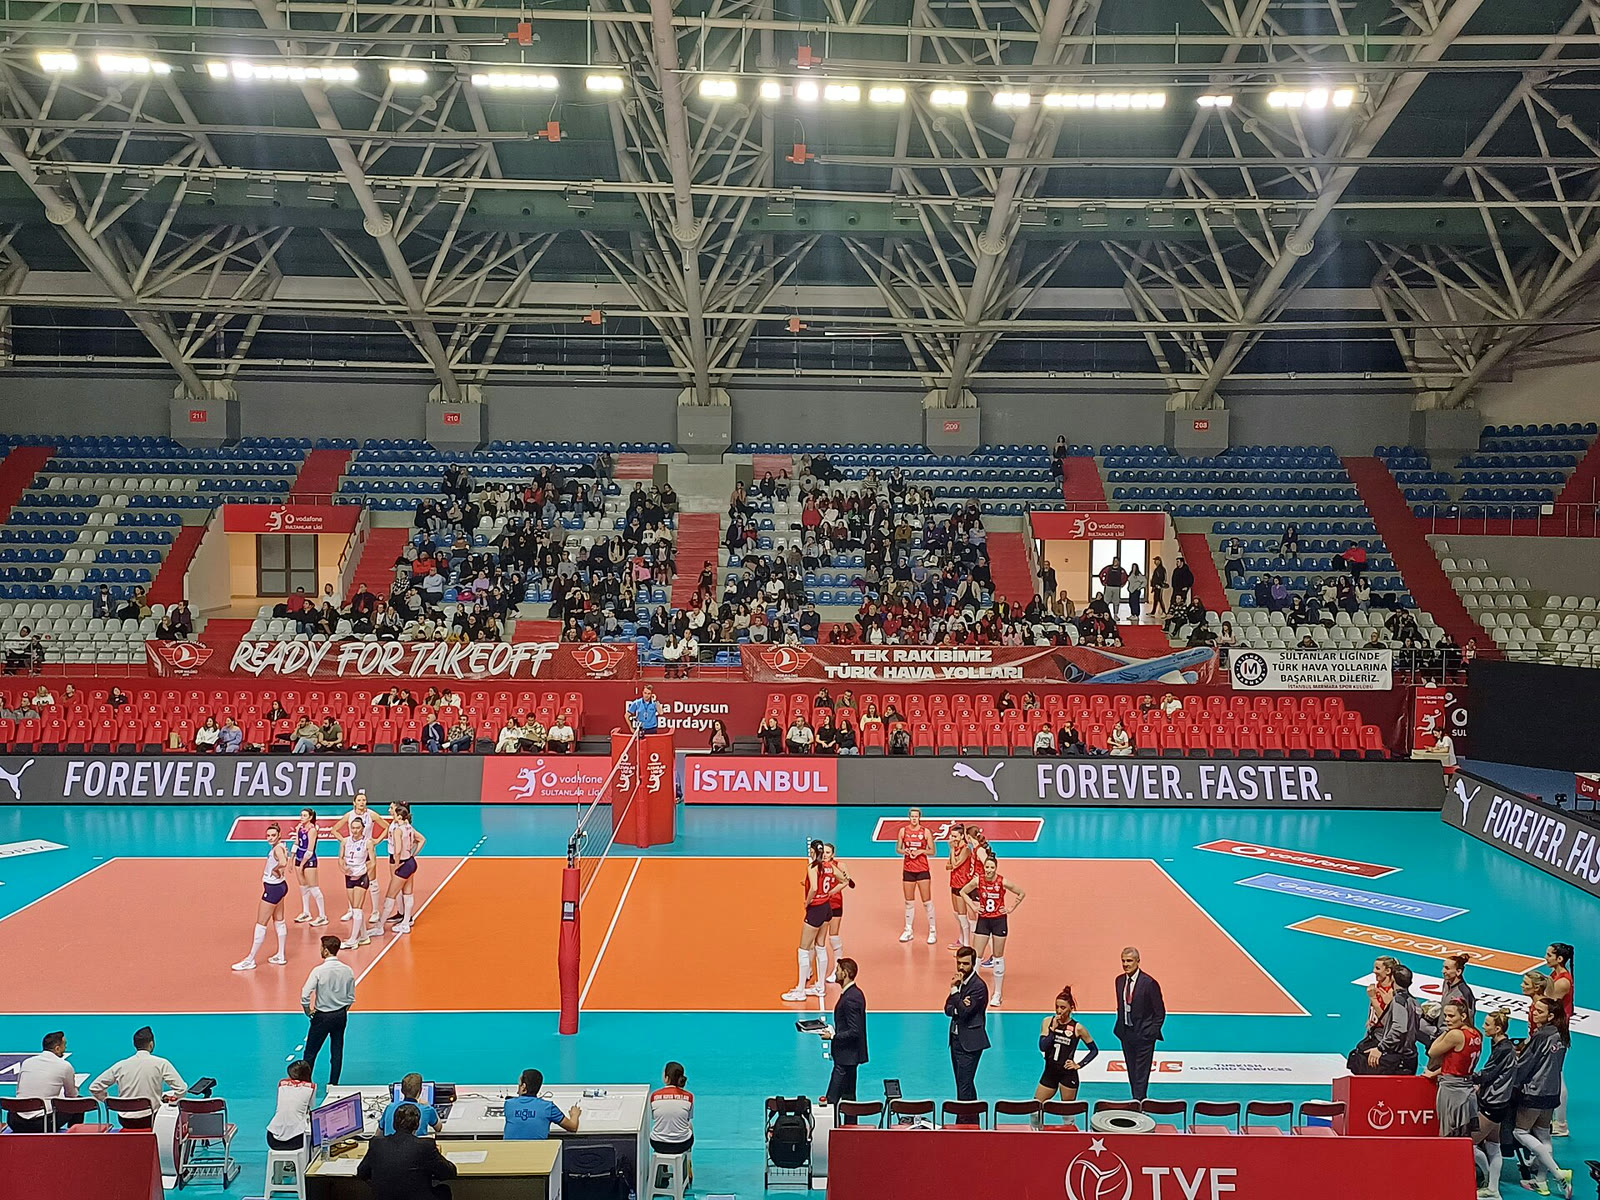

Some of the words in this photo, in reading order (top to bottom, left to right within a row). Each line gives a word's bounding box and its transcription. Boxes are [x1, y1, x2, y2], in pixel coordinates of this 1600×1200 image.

[230, 640, 332, 677] READY
[337, 642, 404, 677] FOR
[408, 642, 560, 679] TAKEOFF
[851, 650, 890, 662] TEK
[894, 646, 992, 662] RAKİBİMİZ
[824, 664, 878, 678] TÜRK
[884, 666, 936, 679] HAVA
[940, 666, 1023, 679] YOLLARI
[1272, 662, 1298, 671] TÜRK
[1280, 674, 1336, 684] BAŞARILAR
[674, 701, 728, 716] Duysun
[658, 717, 715, 732] Burdayı
[63, 761, 224, 796] FOREVER.
[232, 761, 366, 796] FASTER.
[560, 774, 602, 783] vodafone
[694, 764, 828, 792] İSTANBUL
[1037, 764, 1193, 800] FOREVER.
[1199, 765, 1332, 800] FASTER.
[1483, 796, 1566, 868] FOREVER.
[1269, 852, 1361, 871] vodafone
[823, 876, 830, 894] 6
[986, 898, 995, 912] 8
[1343, 926, 1495, 961] trendyol
[1054, 1044, 1060, 1061] 1
[1397, 1110, 1434, 1124] TVF
[1142, 1167, 1237, 1200] TVF
